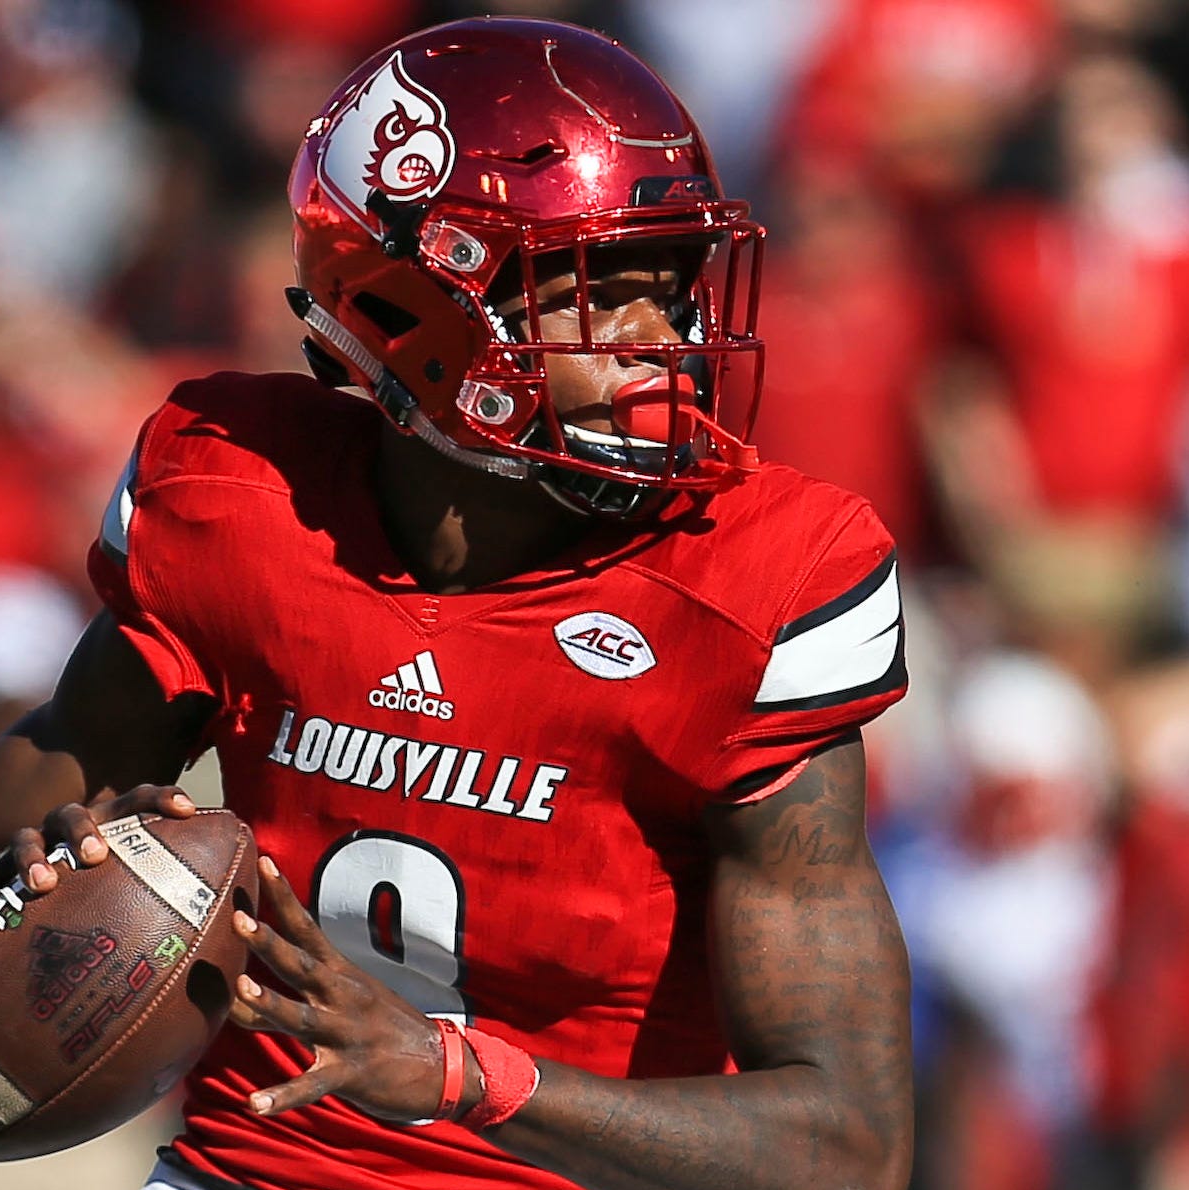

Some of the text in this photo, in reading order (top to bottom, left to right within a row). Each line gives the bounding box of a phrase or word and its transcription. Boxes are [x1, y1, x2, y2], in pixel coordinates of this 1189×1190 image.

[568, 626, 644, 663] ACC
[368, 686, 455, 721] adidas
[267, 710, 569, 823] LOUISVILLE
[32, 934, 117, 1021] adidas
[62, 957, 156, 1060] RIFLE
